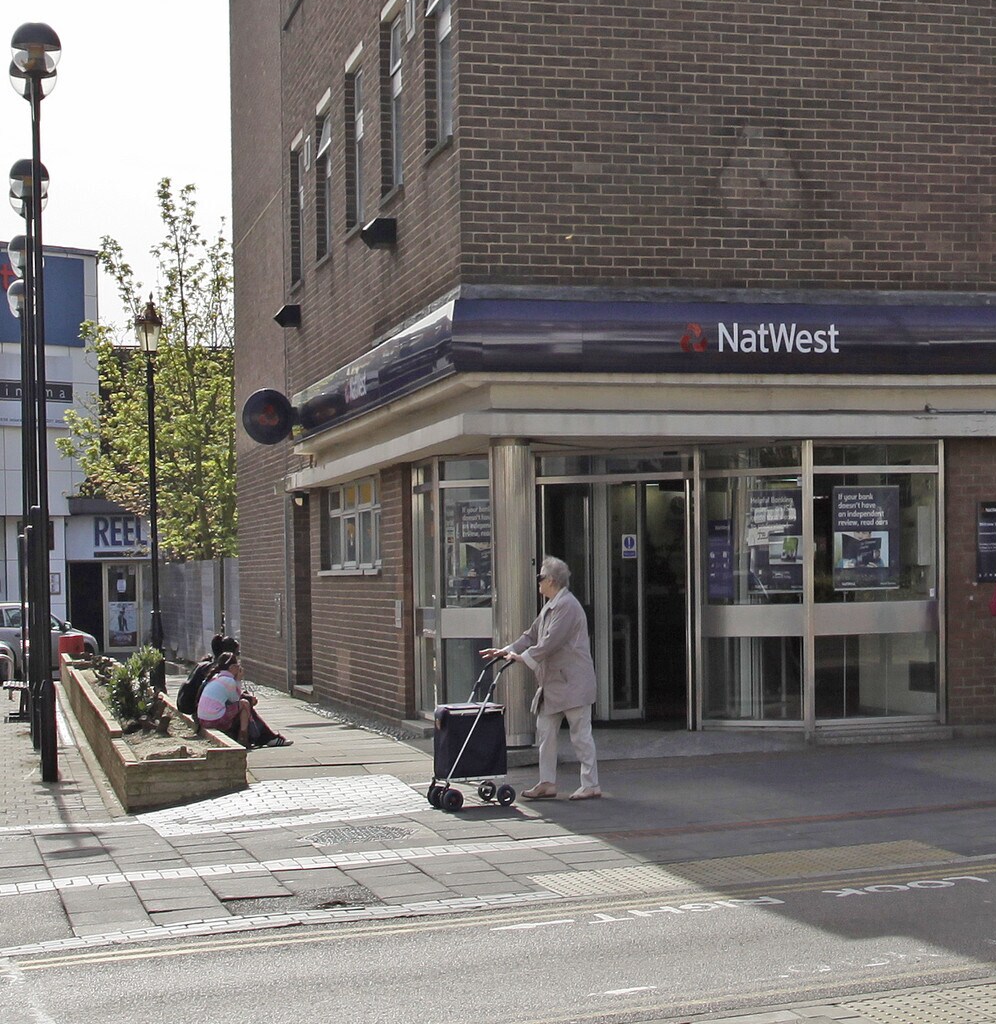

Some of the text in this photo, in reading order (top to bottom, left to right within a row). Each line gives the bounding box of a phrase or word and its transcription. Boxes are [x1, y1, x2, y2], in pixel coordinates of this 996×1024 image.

[717, 322, 840, 354] NatWest
[843, 494, 858, 502] your
[838, 519, 860, 527] review,
[860, 518, 874, 526] read
[847, 509, 885, 519] independent
[94, 516, 149, 547] REEL
[822, 875, 989, 896] LOOK
[588, 895, 786, 924] RIGHT
